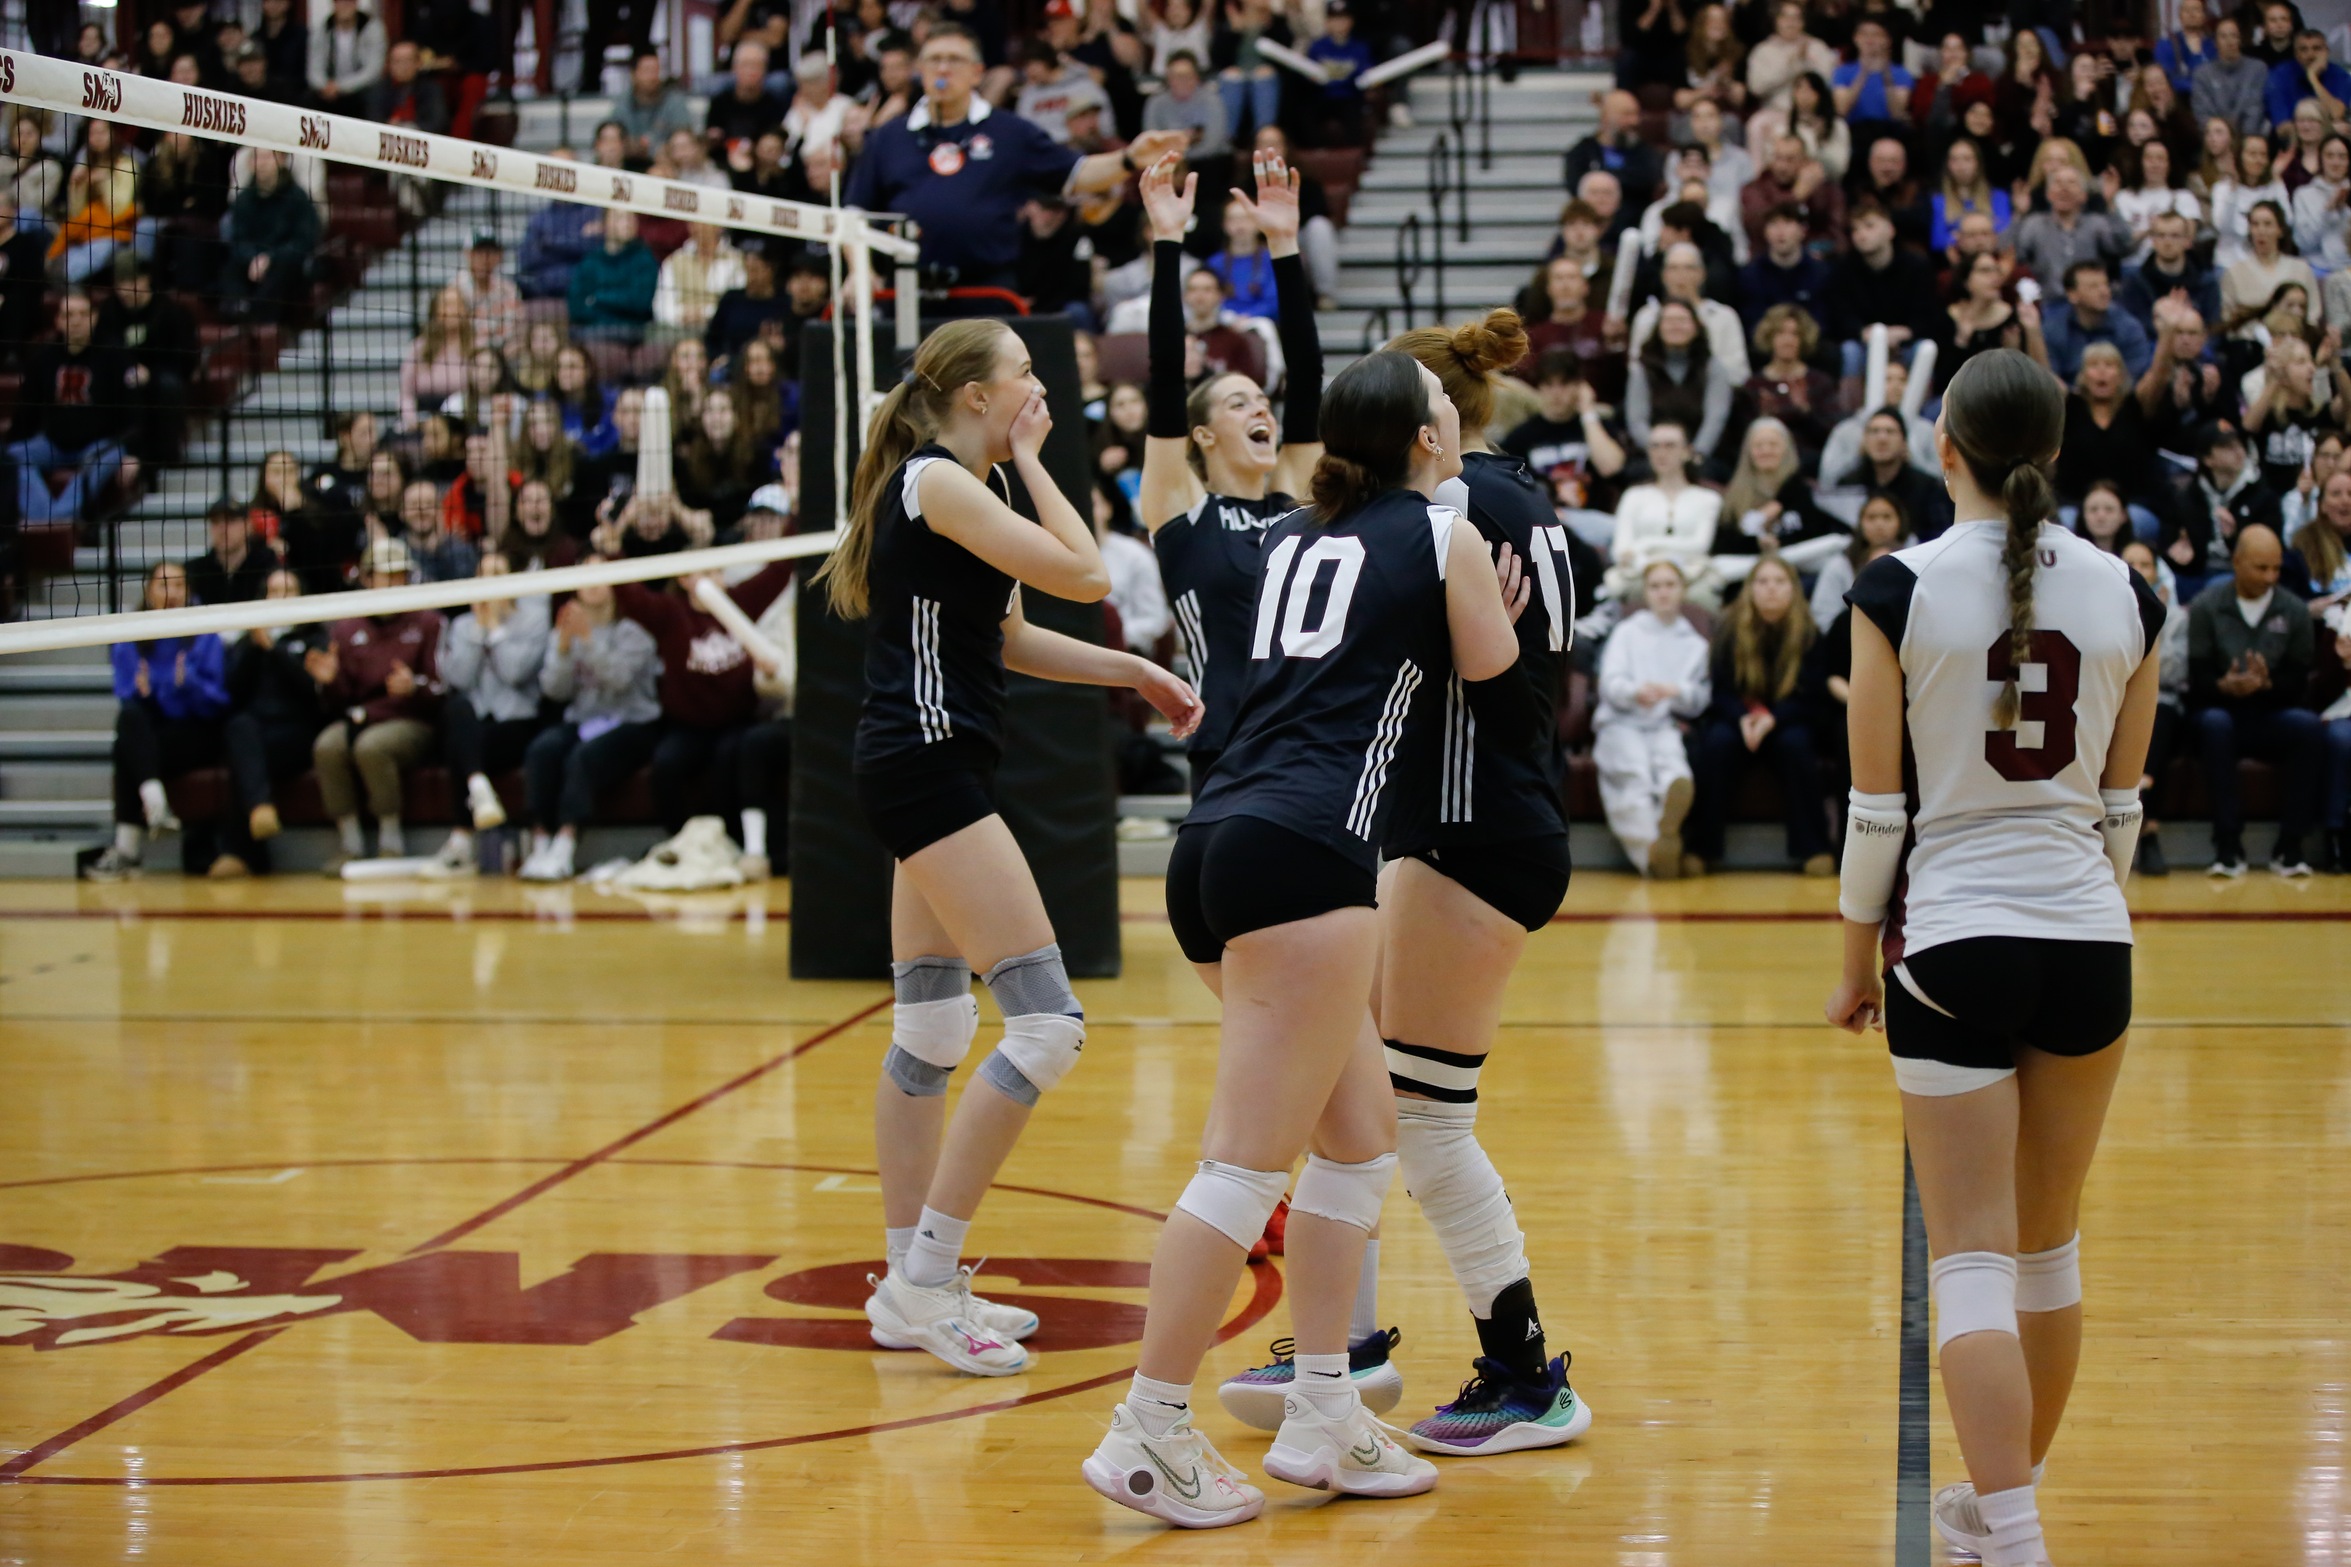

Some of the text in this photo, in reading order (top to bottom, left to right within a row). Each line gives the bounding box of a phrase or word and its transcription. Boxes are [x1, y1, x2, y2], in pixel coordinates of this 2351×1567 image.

[181, 92, 246, 136] HUSKIES
[378, 132, 430, 168] HUSKIES
[1251, 534, 1366, 660] 10
[1529, 524, 1576, 651] 17
[1984, 629, 2081, 782] 3
